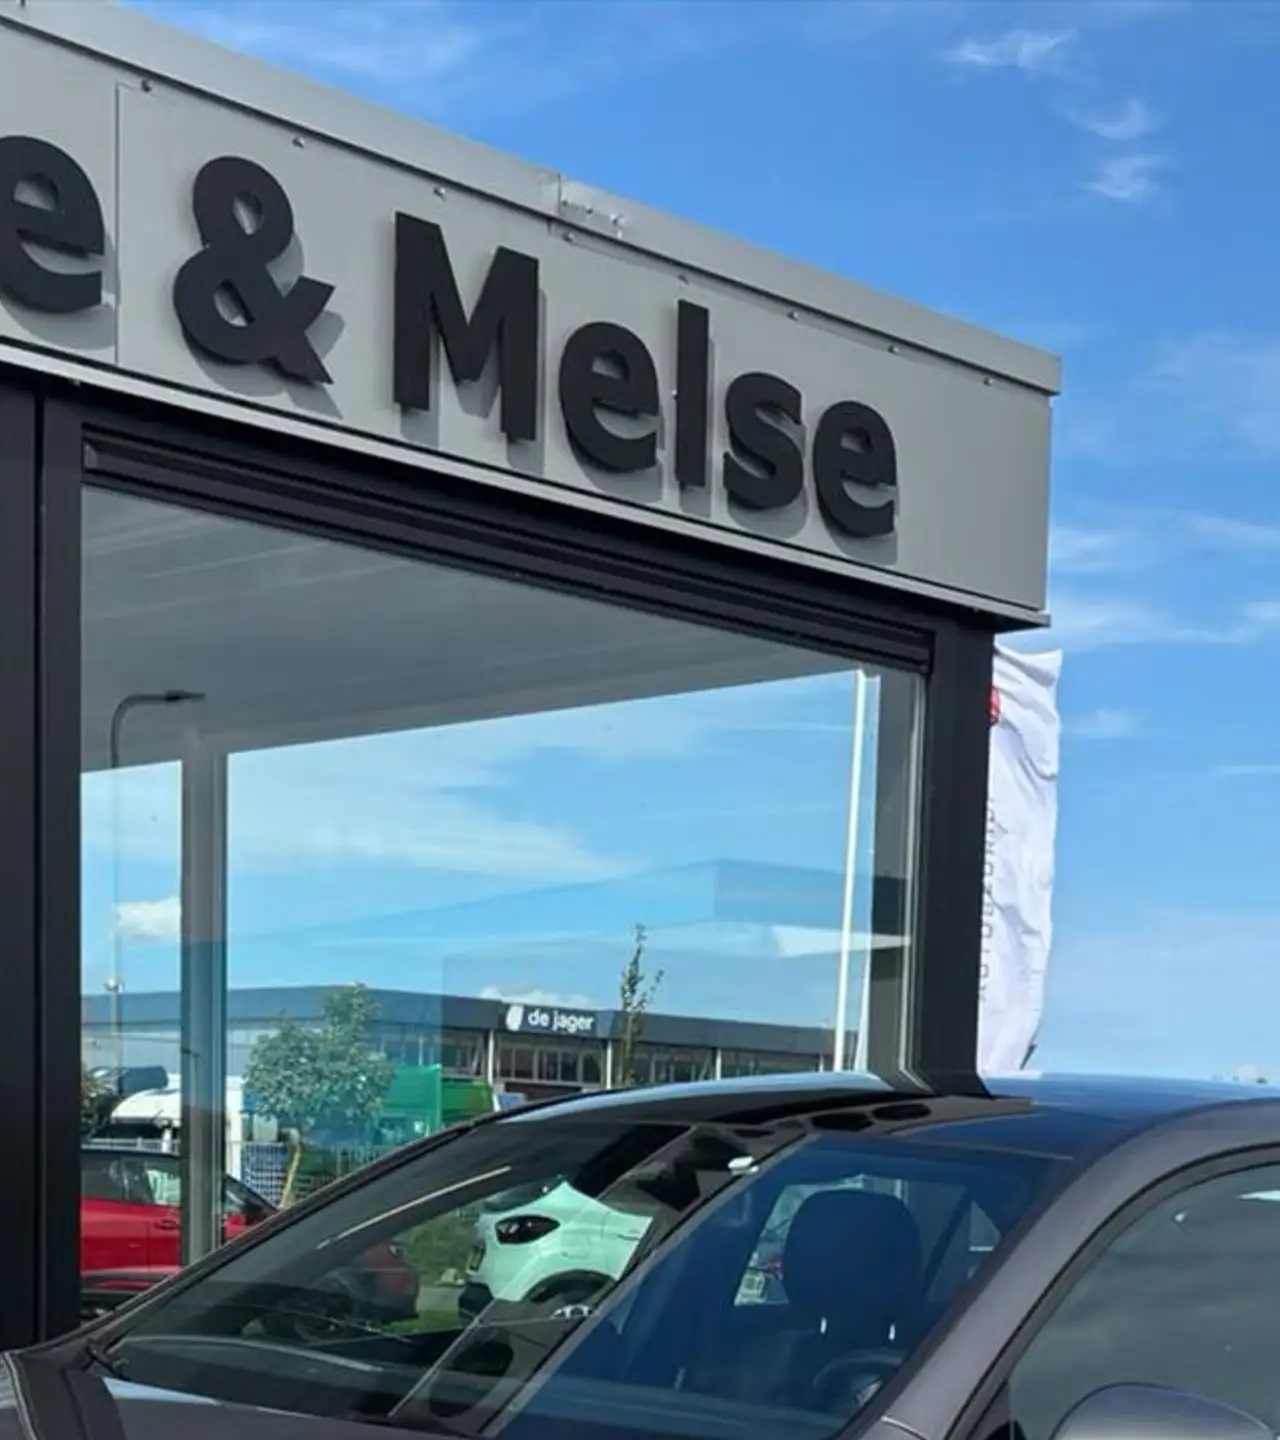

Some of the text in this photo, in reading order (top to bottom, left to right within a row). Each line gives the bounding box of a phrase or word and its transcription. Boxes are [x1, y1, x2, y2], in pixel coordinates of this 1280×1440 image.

[173, 155, 335, 385] &
[393, 211, 898, 538] Melse
[527, 1008, 594, 1034] de jager
